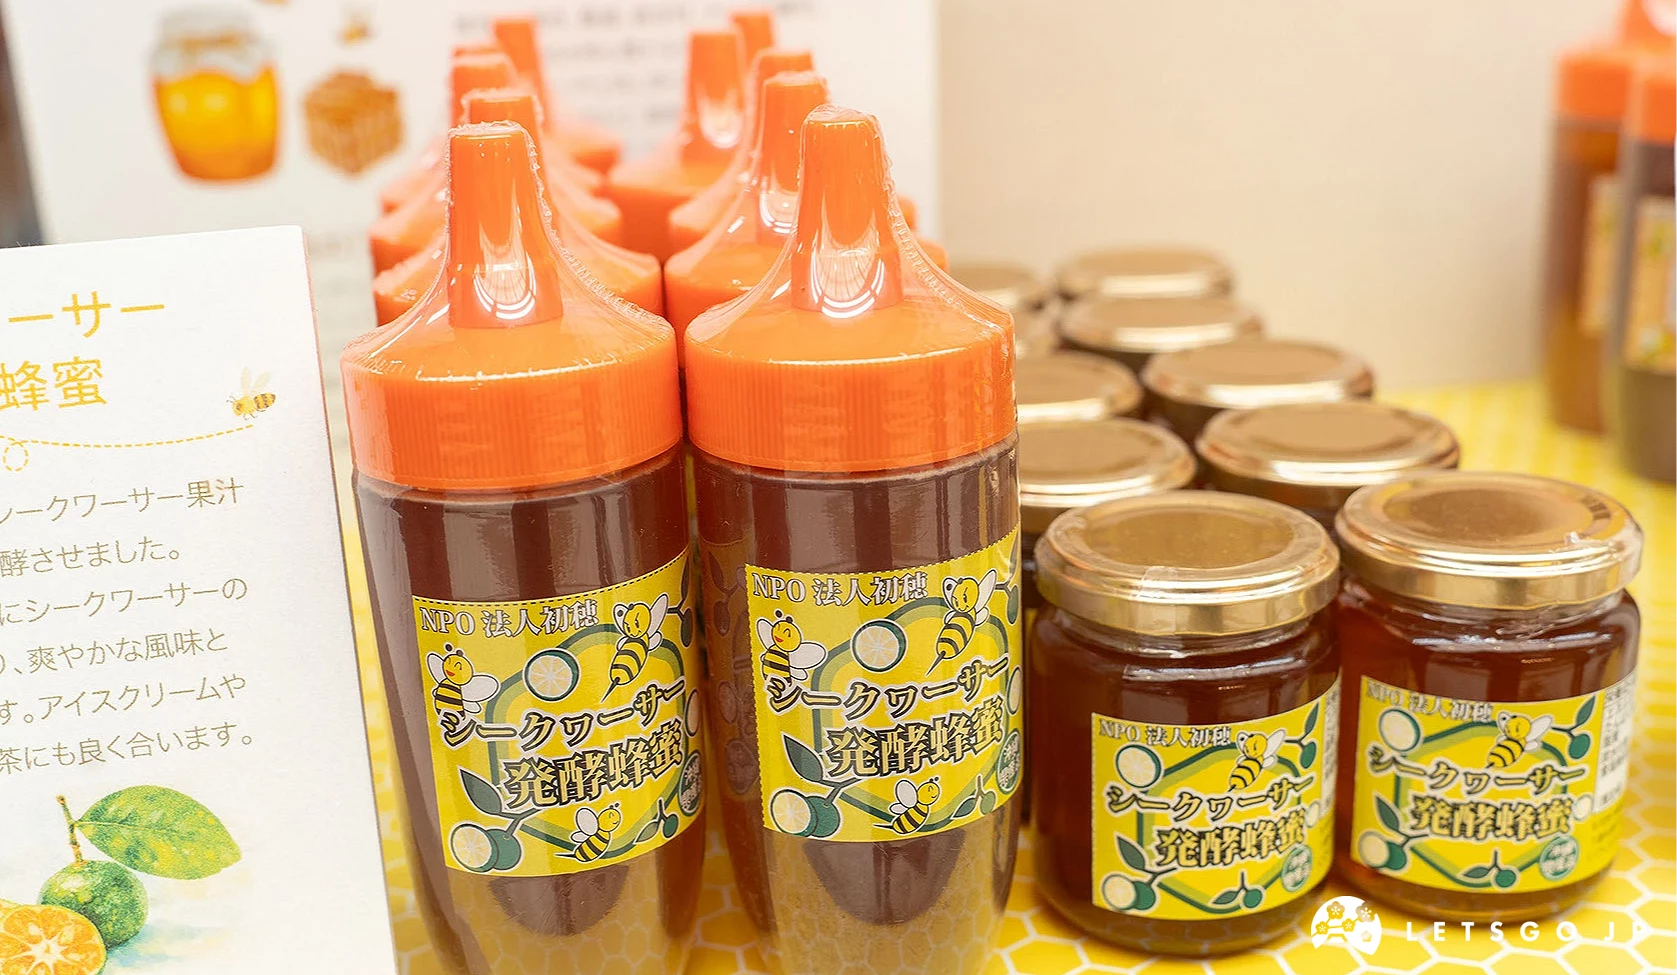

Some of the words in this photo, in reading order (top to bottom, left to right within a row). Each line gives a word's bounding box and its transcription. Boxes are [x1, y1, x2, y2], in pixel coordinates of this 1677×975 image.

[0, 355, 108, 412] 蜂蜜
[0, 535, 180, 577] 酵させました。
[752, 573, 807, 603] NPO
[813, 571, 929, 607] 法人初穂
[420, 607, 475, 635] NPO
[481, 598, 600, 638] 法人初穂
[0, 721, 252, 775] 茶にも良く合います。
[827, 694, 1005, 777] 発酵蜂蜜
[1098, 718, 1142, 743] NPO
[503, 718, 684, 809] 発酵蜂蜜
[1155, 809, 1306, 868] 発酵蜂蜜
[1409, 794, 1575, 842] 発酵蜂蜜
